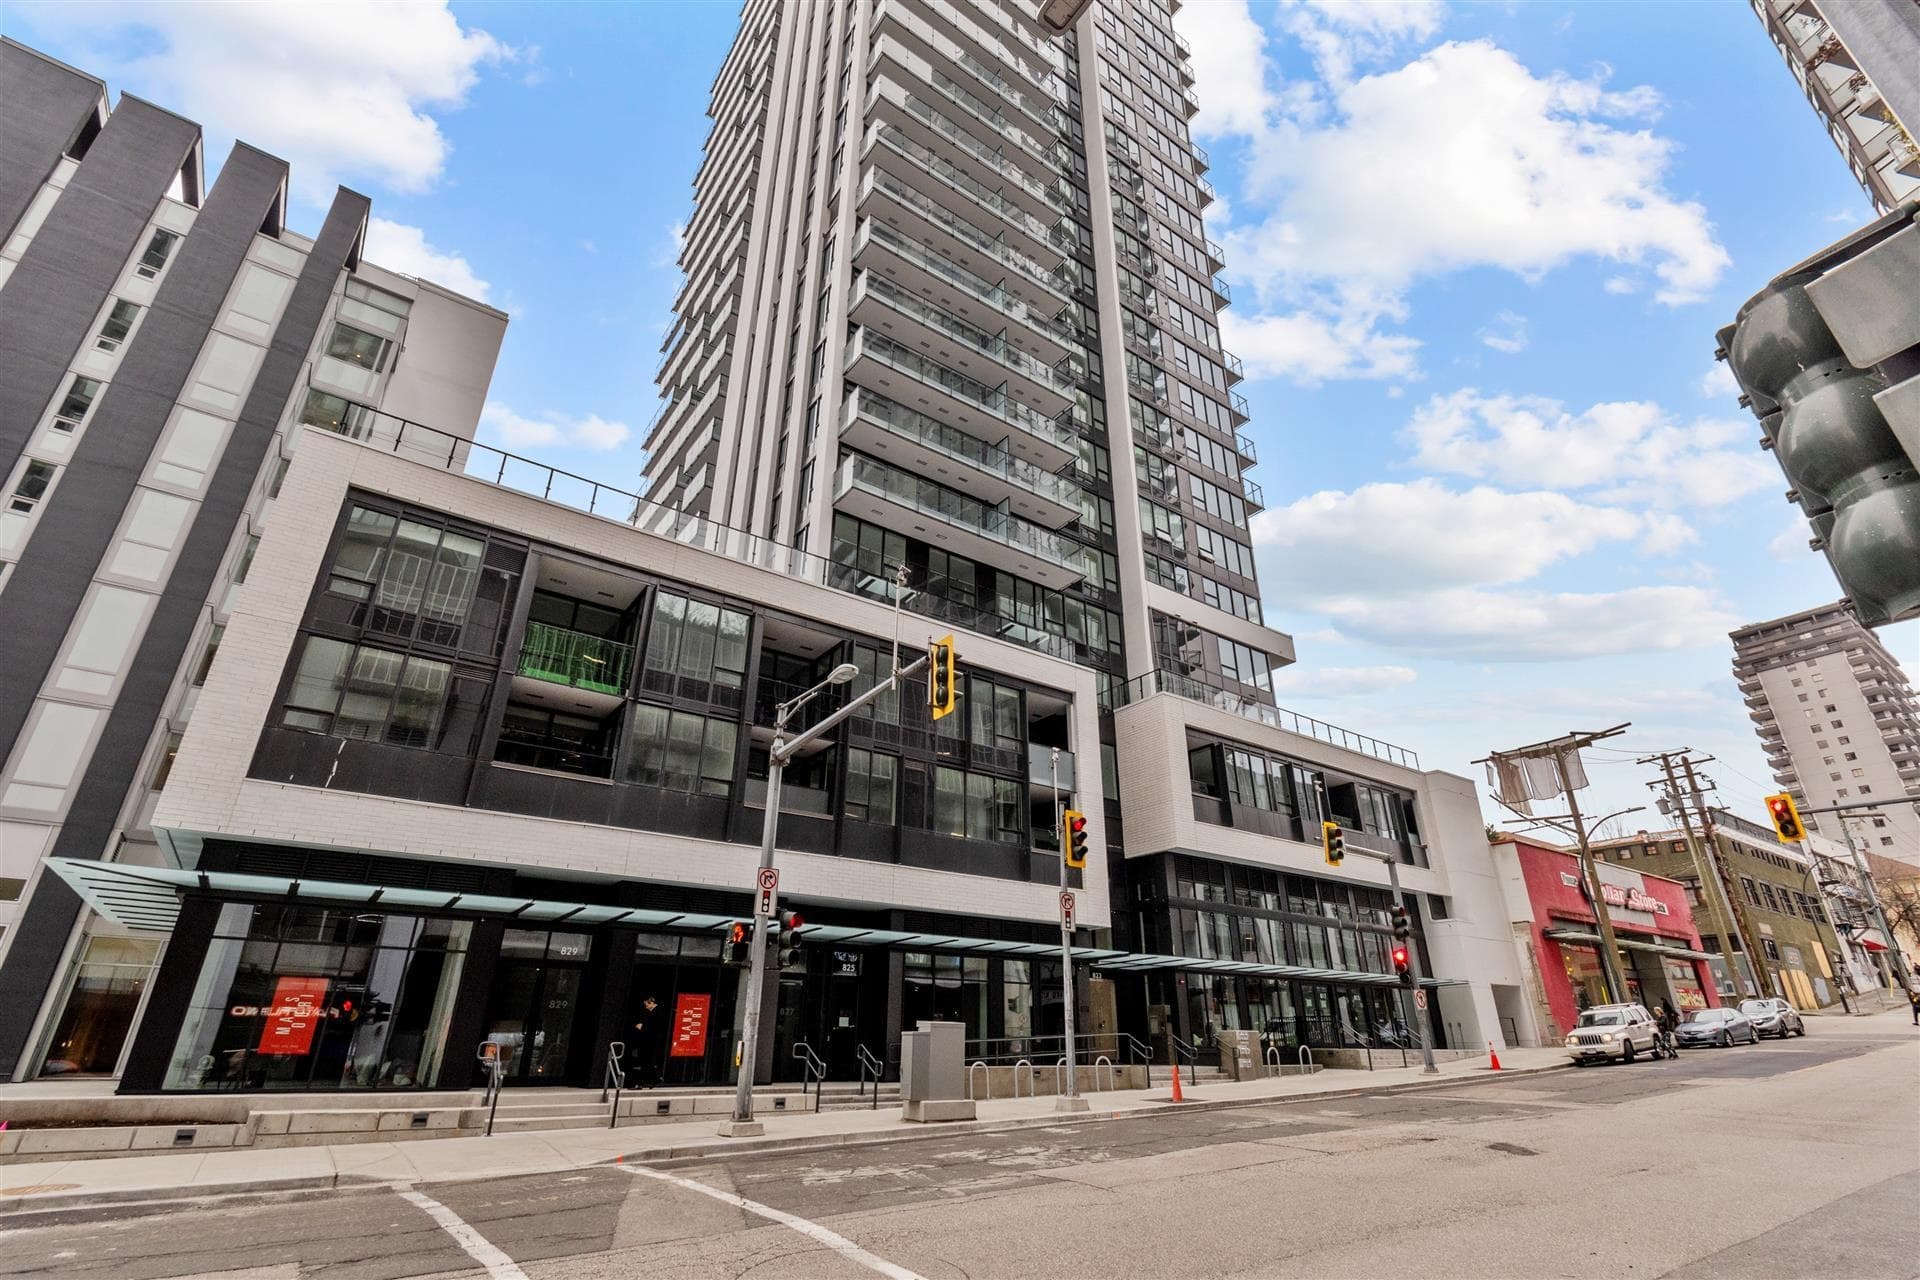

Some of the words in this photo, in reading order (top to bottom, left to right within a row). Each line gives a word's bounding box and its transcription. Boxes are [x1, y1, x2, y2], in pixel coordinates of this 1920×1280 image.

[1629, 887, 1658, 911] Store
[561, 946, 578, 956] 829
[842, 963, 855, 972] 825
